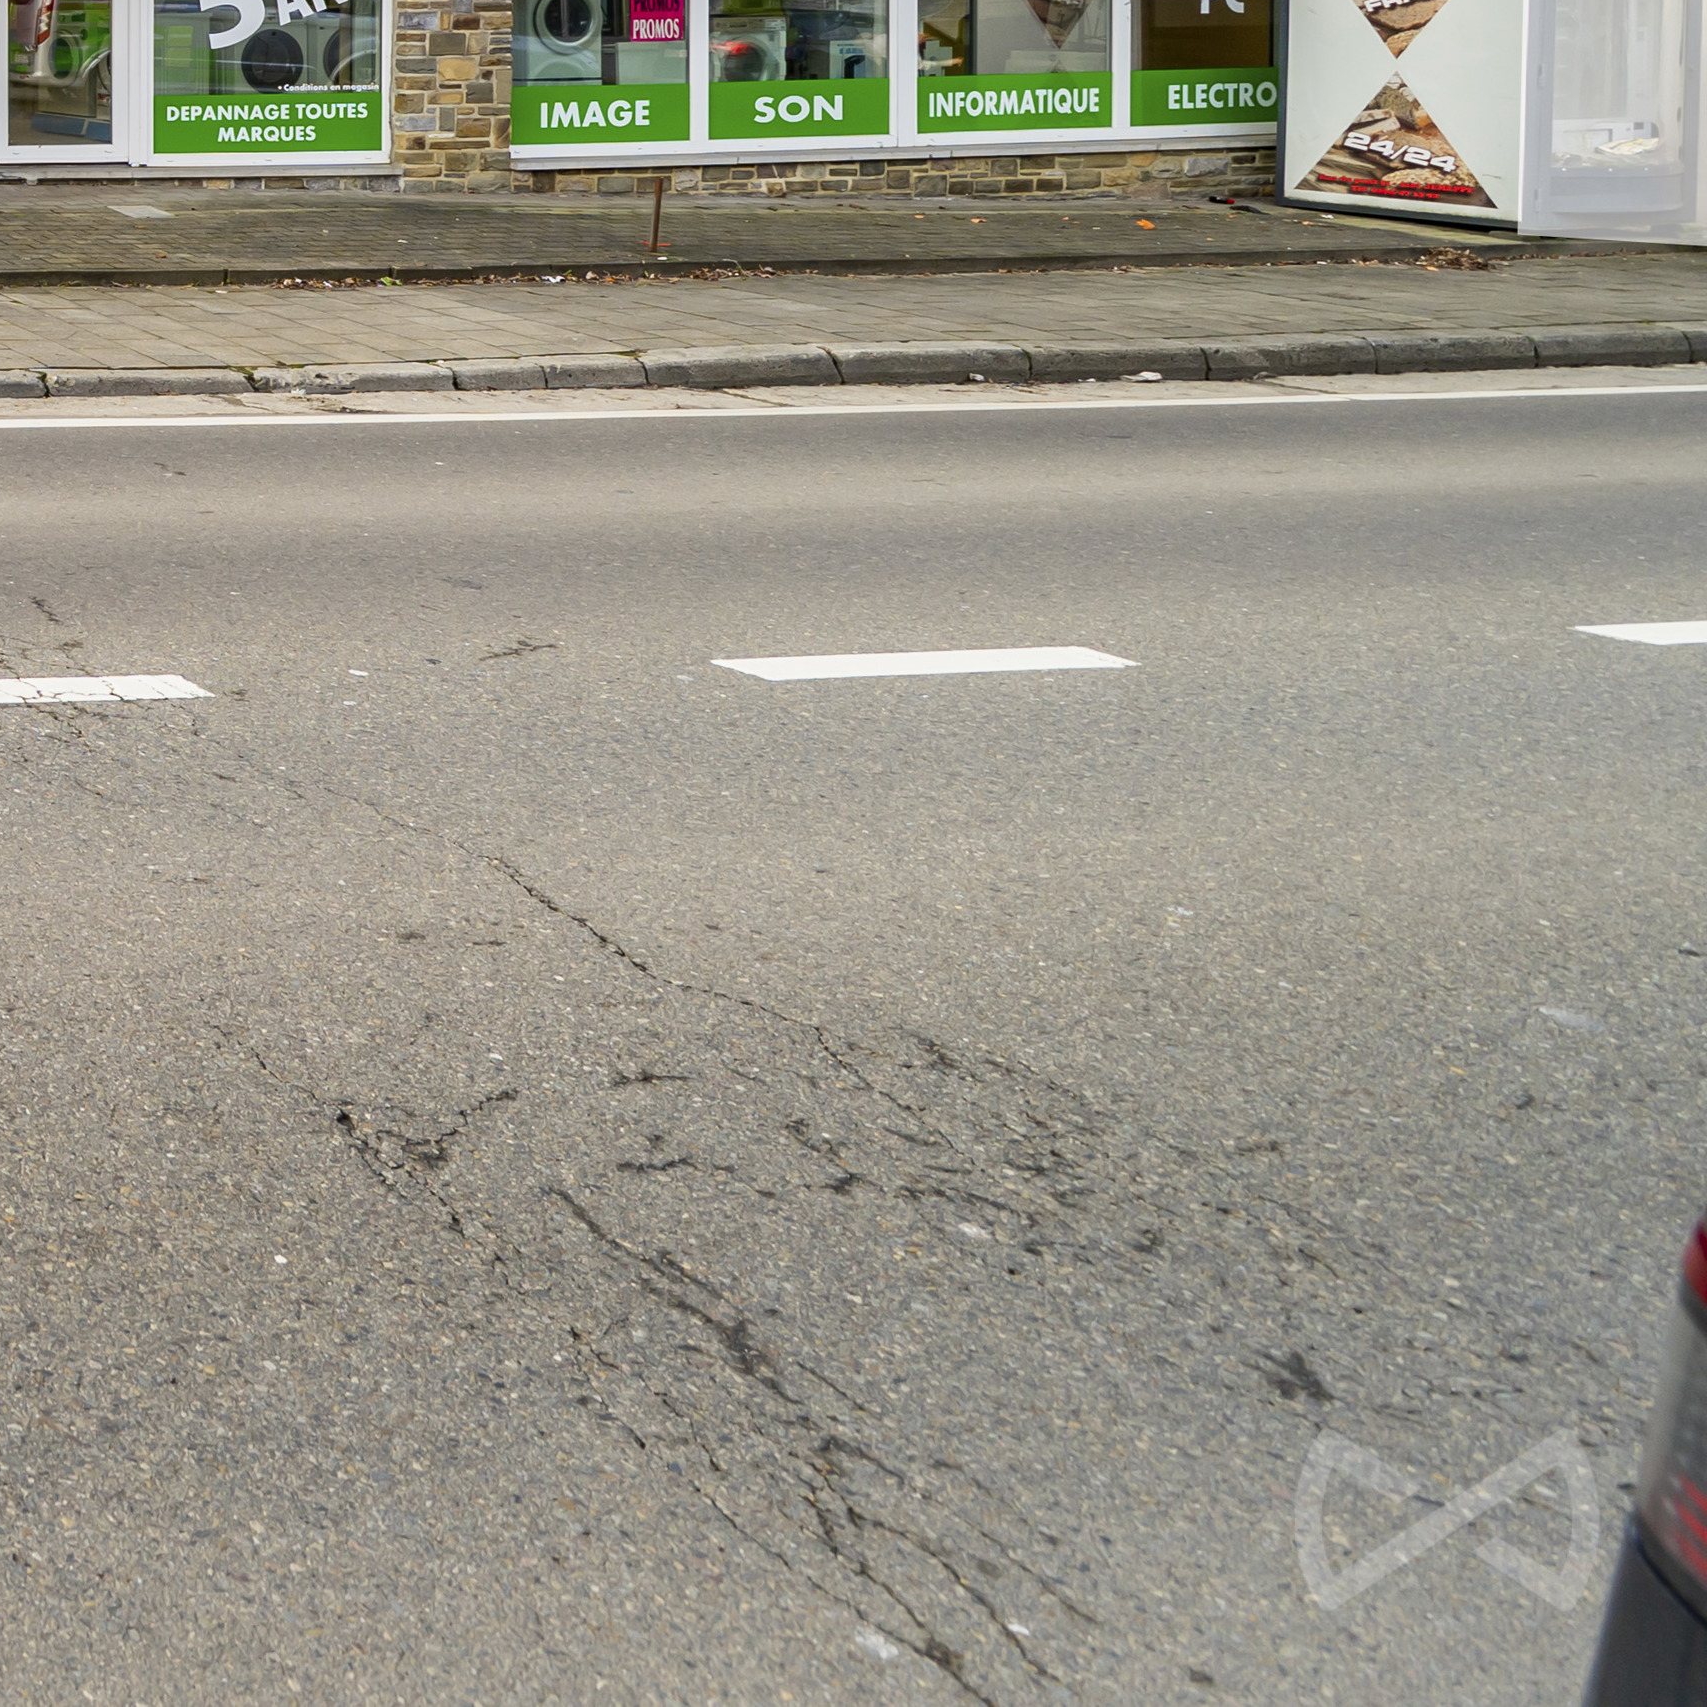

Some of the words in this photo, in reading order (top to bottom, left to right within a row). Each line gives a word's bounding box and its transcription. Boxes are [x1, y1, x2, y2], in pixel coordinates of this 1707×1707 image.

[632, 18, 680, 40] PROMOS
[283, 83, 328, 92] Conditions
[342, 82, 380, 92] magasin
[1167, 81, 1278, 110] ELECTRO
[166, 103, 290, 122] DEPANNAGE
[295, 102, 369, 120] TOUTES
[540, 100, 651, 129] IMAGE
[753, 95, 844, 124] SON
[929, 87, 1100, 118] INFORMATIQUE
[217, 125, 317, 142] MARQUES
[1343, 131, 1459, 173] 24/24
